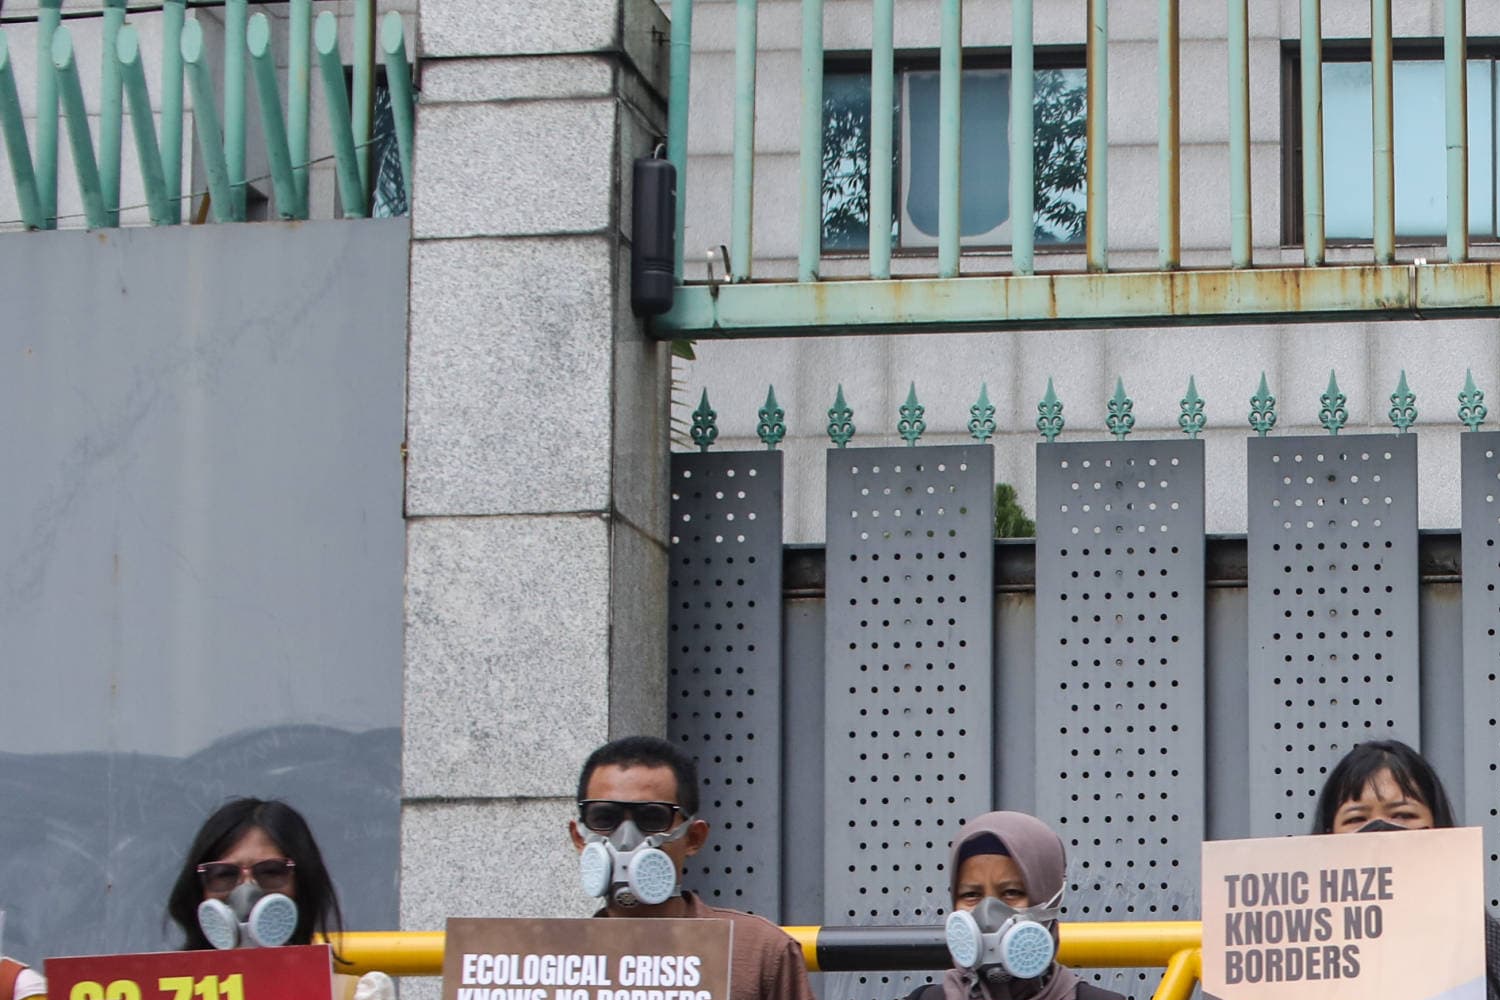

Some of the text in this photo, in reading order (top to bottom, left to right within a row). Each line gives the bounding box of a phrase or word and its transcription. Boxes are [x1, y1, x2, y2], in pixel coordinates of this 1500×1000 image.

[1224, 866, 1394, 909] TOXIC HAZE
[1225, 904, 1384, 946] KNOWS NO
[462, 954, 701, 987] ECOLOGICAL CRISIS
[1225, 944, 1361, 985] BORDERS
